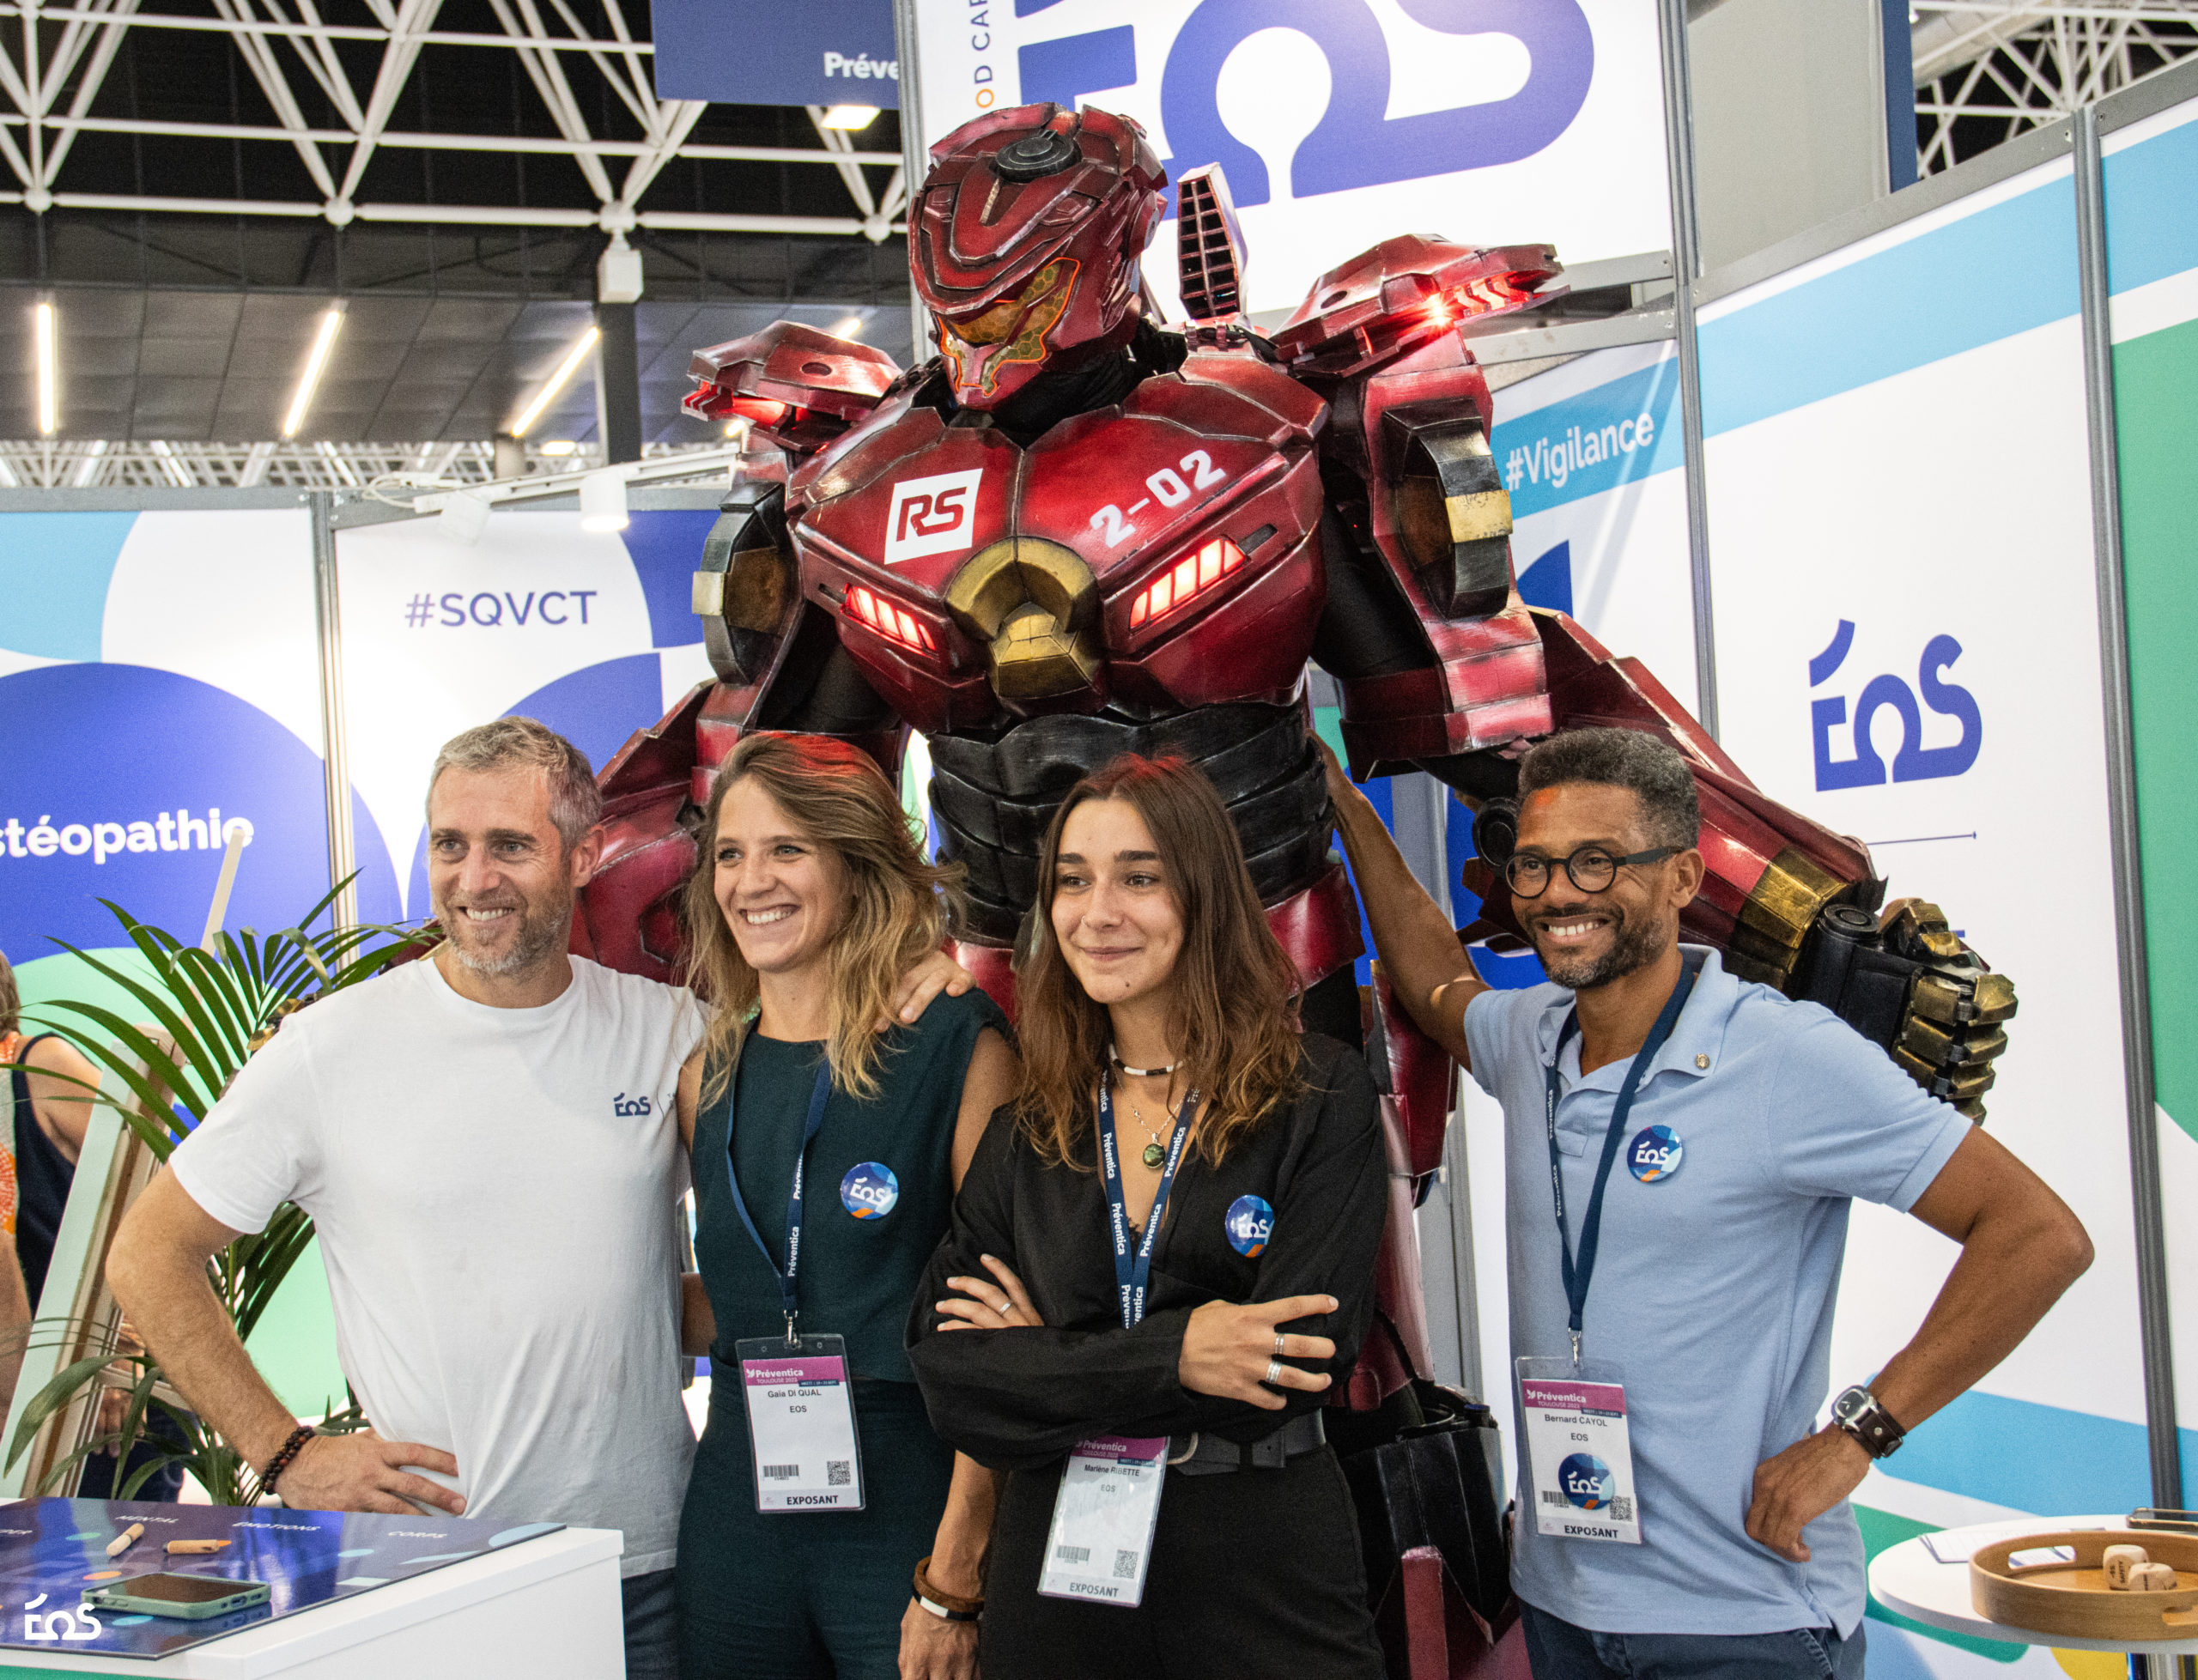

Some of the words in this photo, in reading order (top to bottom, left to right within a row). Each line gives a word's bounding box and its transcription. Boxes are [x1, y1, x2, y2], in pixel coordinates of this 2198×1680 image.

[1506, 413, 1654, 491] #Vigilance
[896, 487, 967, 543] RS
[1090, 450, 1226, 549] 2-02
[405, 591, 598, 628] #SQVCT
[1103, 1132, 1115, 1179] Préventica
[1164, 1126, 1187, 1177] Préventica
[1112, 1203, 1126, 1255] Préventica
[1140, 1204, 1162, 1258] Préventica
[787, 1226, 799, 1277] Préventica
[756, 1368, 805, 1378] Préventica
[1536, 1391, 1588, 1403] Préventica
[1545, 1414, 1578, 1423] Bernard
[1579, 1416, 1608, 1427] CAYOL
[1570, 1433, 1588, 1441] EOS
[786, 1495, 839, 1505] EXPOSANT
[1101, 1483, 1116, 1492] EOS
[1564, 1525, 1618, 1538] EXPOSANT
[1070, 1582, 1119, 1598] EXPOSANT
